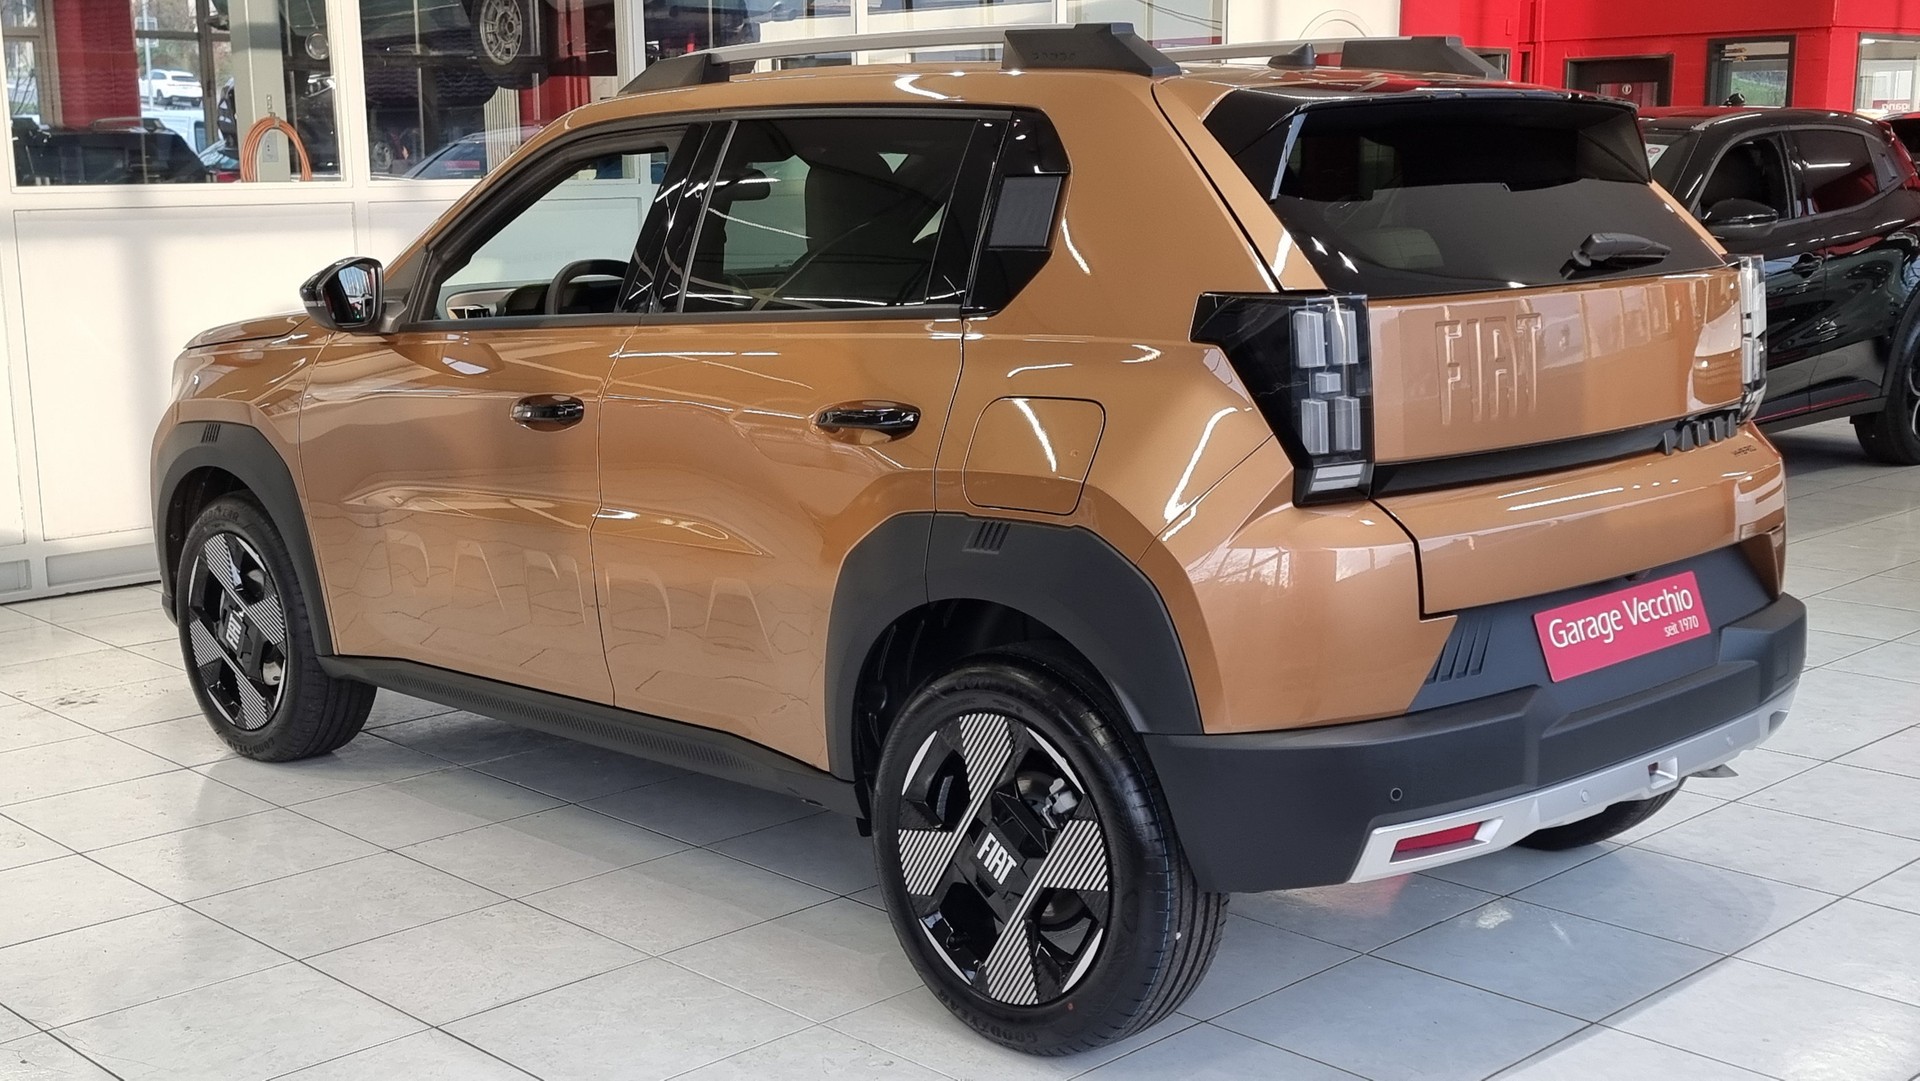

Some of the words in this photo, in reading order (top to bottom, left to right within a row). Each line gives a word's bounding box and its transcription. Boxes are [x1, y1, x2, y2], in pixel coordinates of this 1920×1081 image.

[1435, 313, 1543, 425] FIAT
[226, 613, 241, 650] FIAT
[1549, 610, 1623, 648] Garage
[1622, 585, 1693, 625] Vecchio
[1664, 622, 1679, 637] seit
[1679, 615, 1699, 630] 1970
[977, 832, 1017, 885] FIAT
